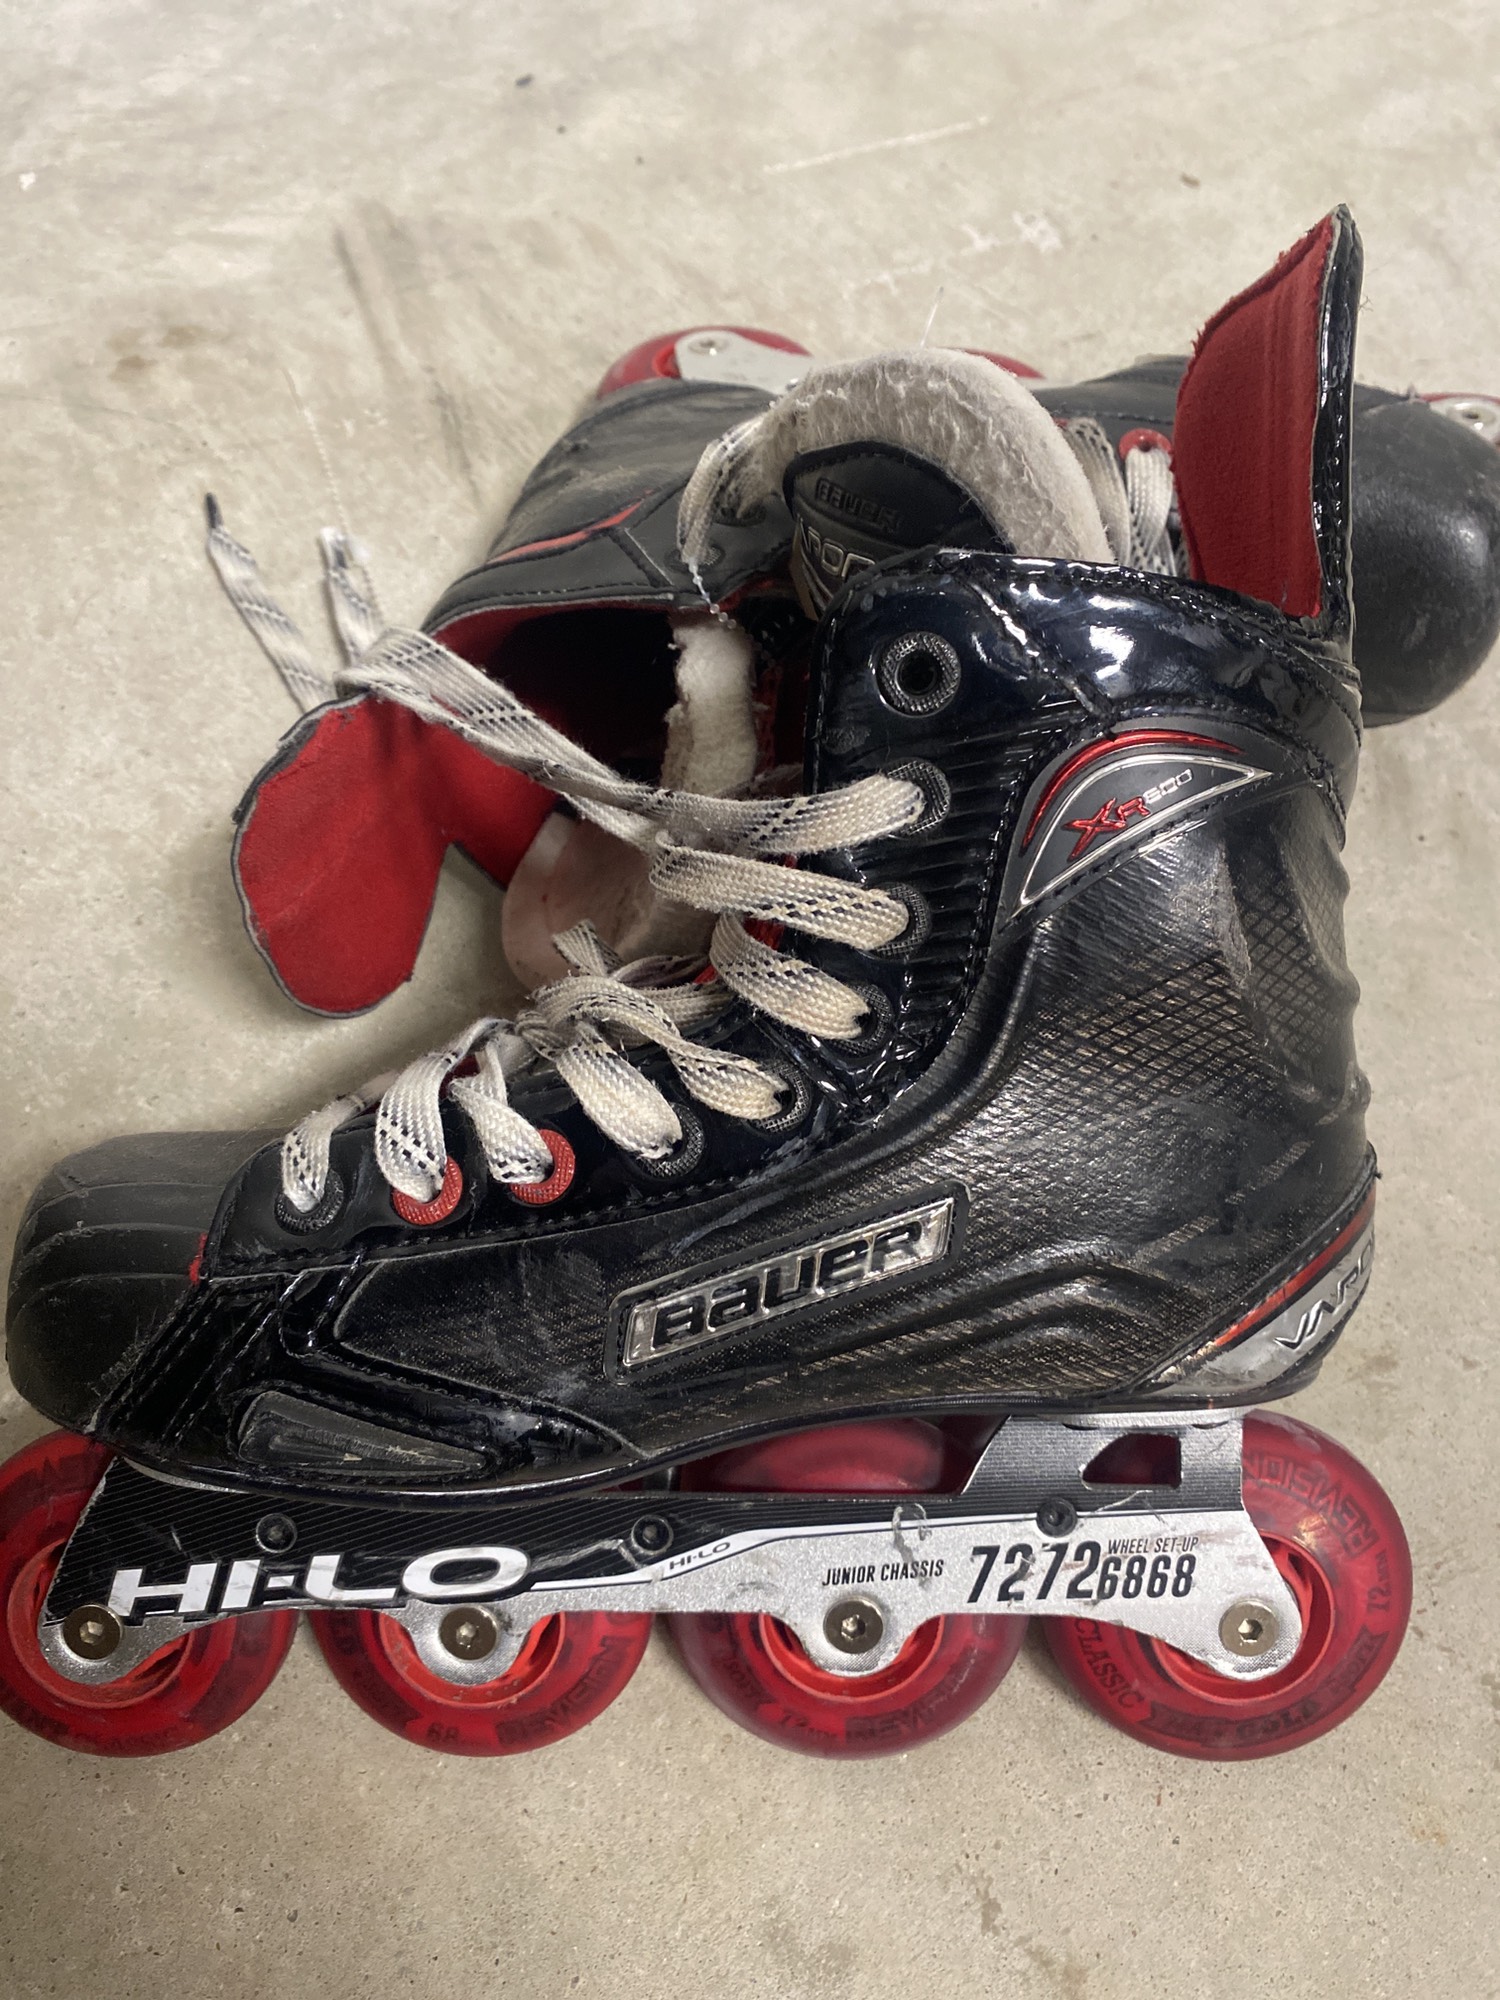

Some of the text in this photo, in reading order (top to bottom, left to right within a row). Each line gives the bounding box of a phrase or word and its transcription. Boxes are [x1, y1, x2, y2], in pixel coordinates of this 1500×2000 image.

[652, 1218, 926, 1351] BAUER
[669, 1541, 731, 1571] HI-LO
[821, 1558, 945, 1587] JUNIOR CHASSIS
[967, 1540, 1100, 1604] 7272
[1108, 1536, 1200, 1555] WHEEL SET-UP
[107, 1546, 530, 1618] HI-LO
[1096, 1553, 1198, 1600] 6868
[1074, 1616, 1143, 1711] CLASSIC
